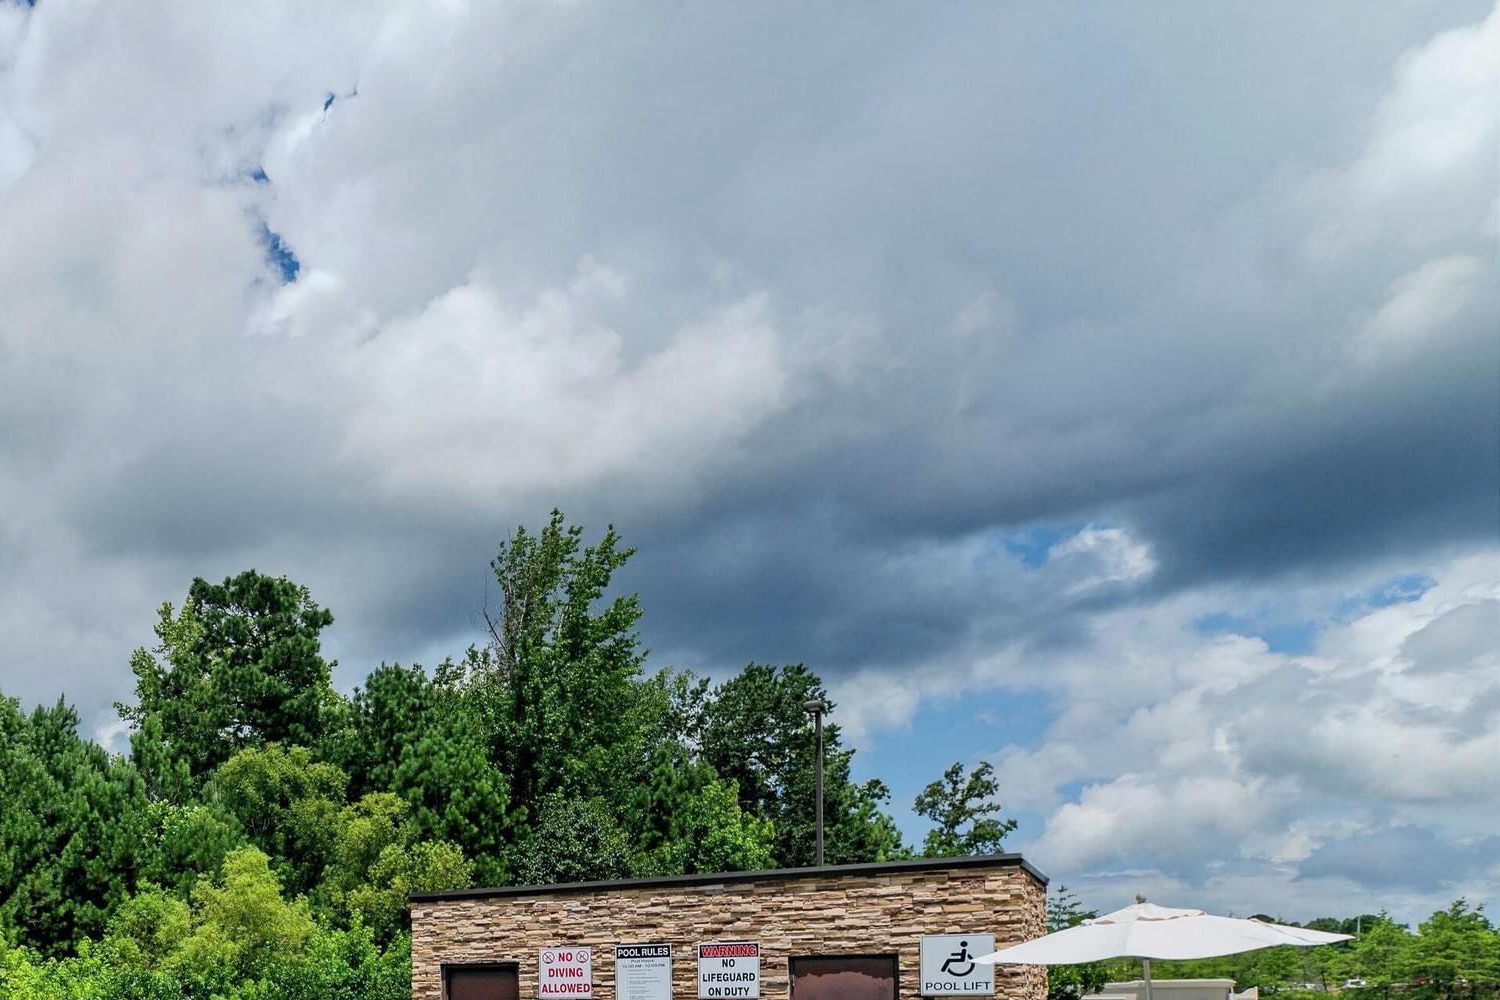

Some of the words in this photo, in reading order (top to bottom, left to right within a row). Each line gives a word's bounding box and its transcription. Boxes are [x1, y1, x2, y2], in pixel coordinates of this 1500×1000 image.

[617, 948, 641, 957] POOL
[641, 947, 669, 956] RULES
[701, 944, 757, 958] WARNING
[558, 952, 573, 962] NO
[721, 959, 735, 968] NO
[548, 968, 583, 978] DIVING
[702, 973, 756, 982] LIFEGUARD
[541, 983, 590, 993] ALLOWED
[925, 982, 961, 991] POOL
[963, 981, 992, 991] LIFT
[708, 987, 721, 996] ON
[724, 987, 750, 996] DUTY
